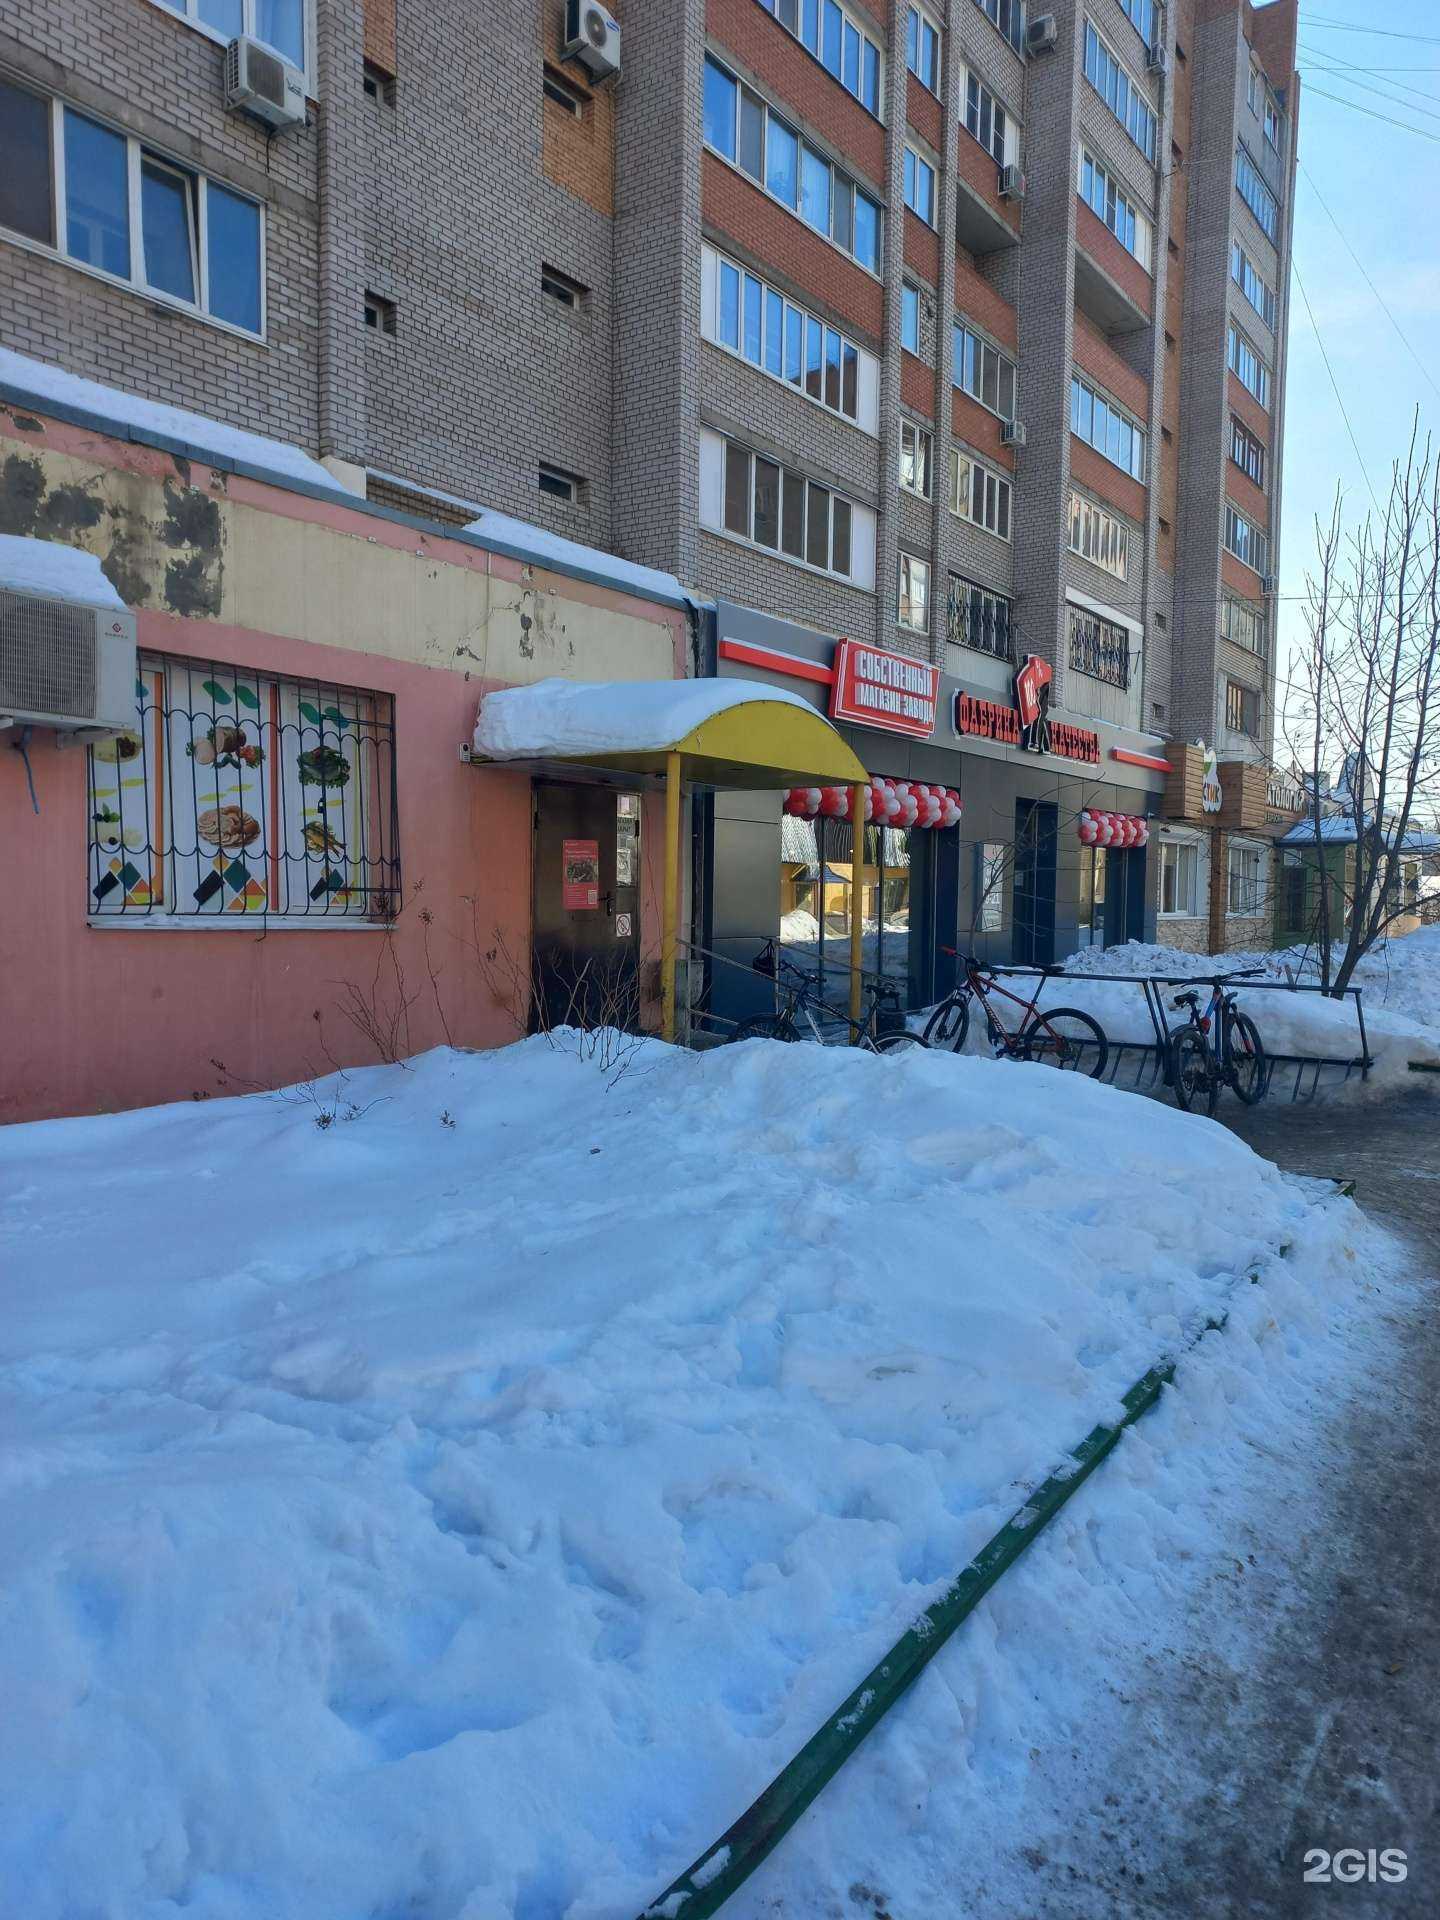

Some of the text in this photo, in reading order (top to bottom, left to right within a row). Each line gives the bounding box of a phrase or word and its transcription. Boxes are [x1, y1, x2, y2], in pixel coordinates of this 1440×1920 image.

[857, 649, 933, 697] СОБСТВЕННЫЙ
[857, 682, 934, 726] МАГАЗИН ЗАВОДА
[959, 692, 1100, 763] ФАБРИКА КАЧЕСТВА
